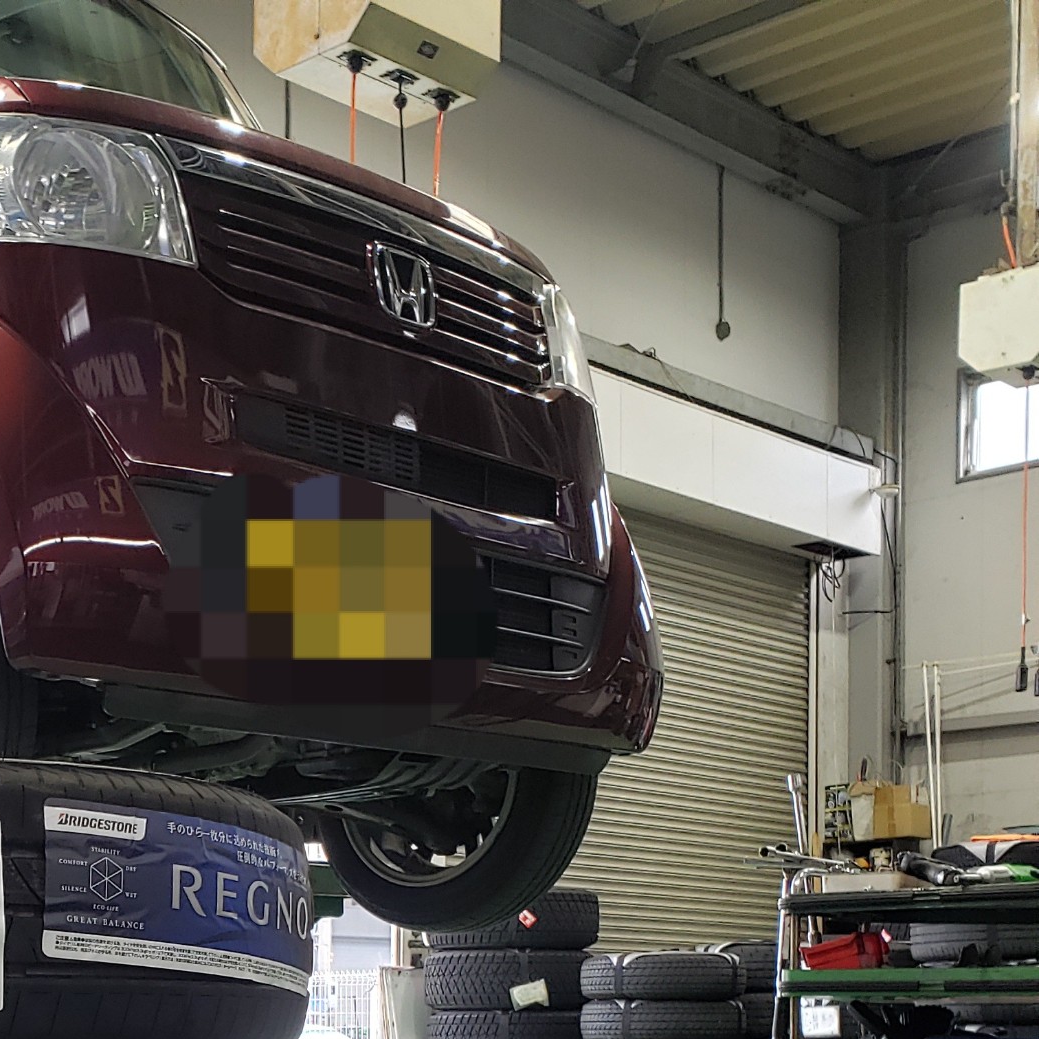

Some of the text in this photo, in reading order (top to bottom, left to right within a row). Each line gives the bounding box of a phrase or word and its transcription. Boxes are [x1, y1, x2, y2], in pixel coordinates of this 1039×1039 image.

[57, 813, 138, 835] BRIDGESTONE
[171, 863, 308, 941] REGNO
[66, 914, 145, 930] GREAT BALANCE
